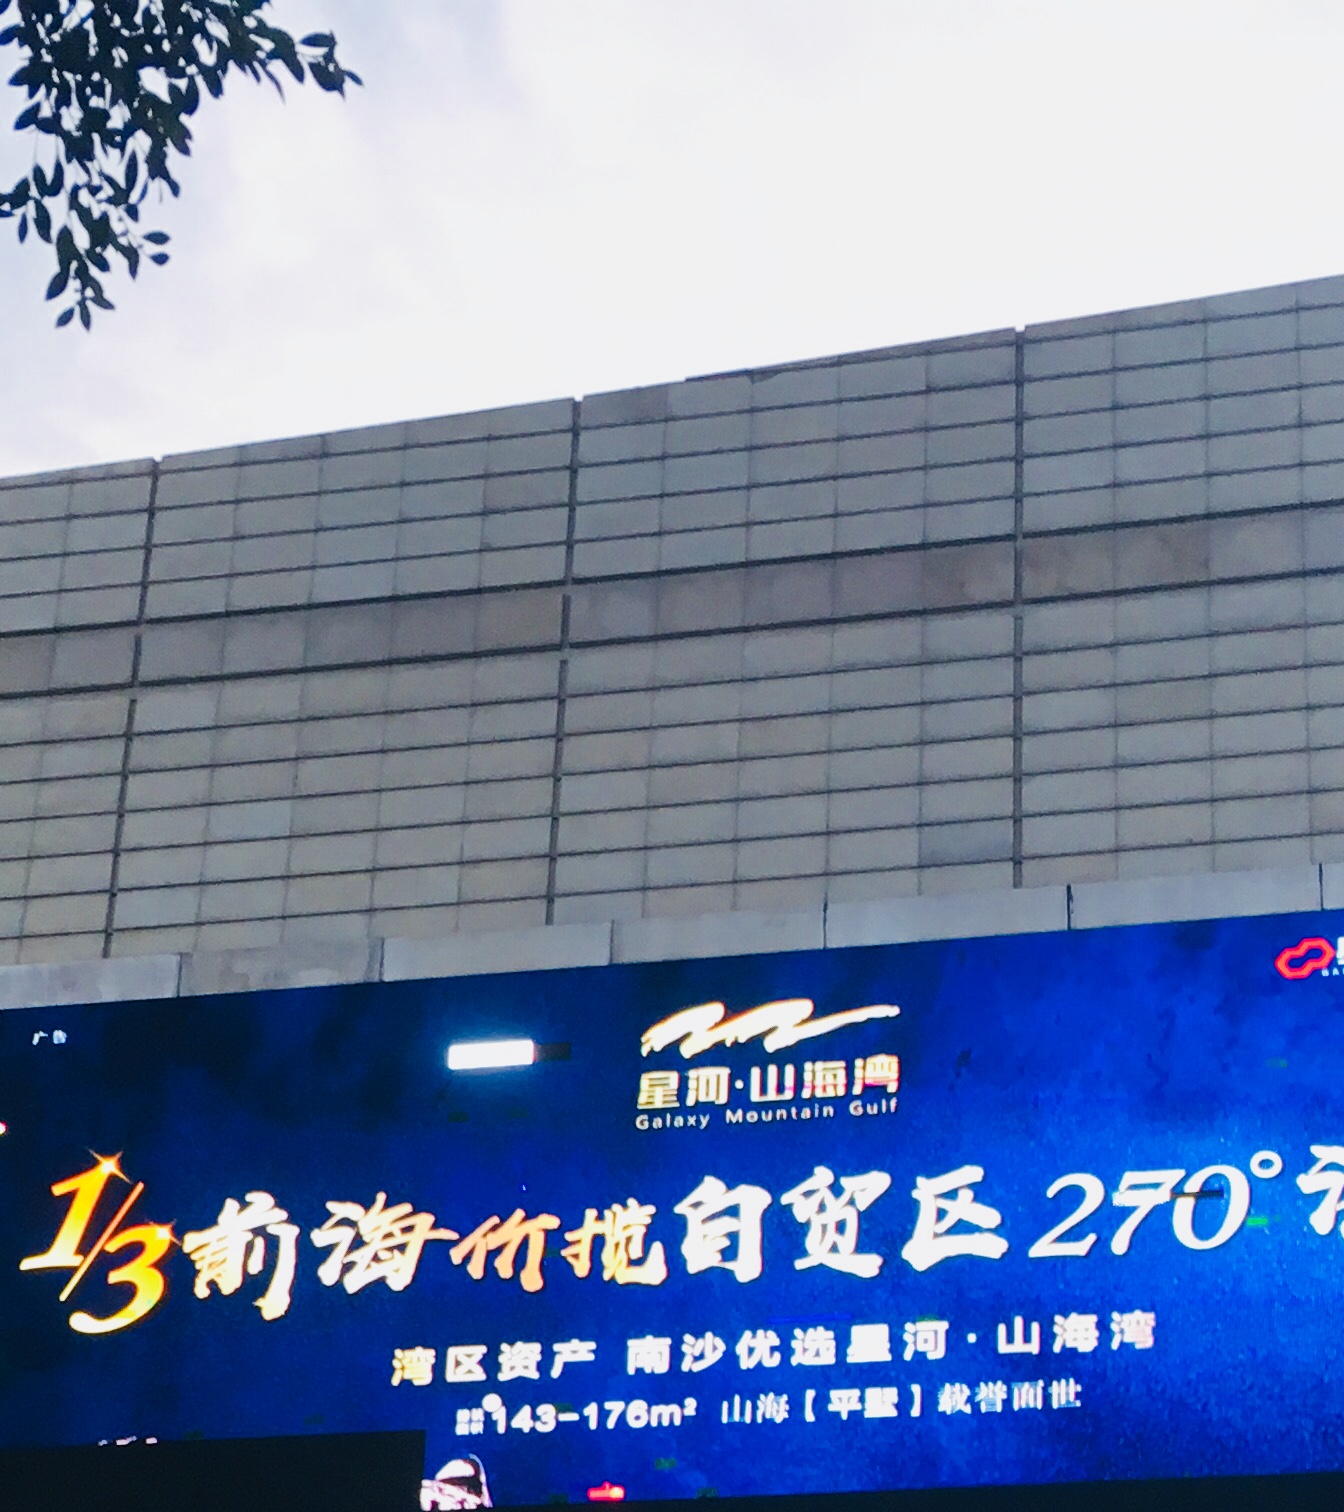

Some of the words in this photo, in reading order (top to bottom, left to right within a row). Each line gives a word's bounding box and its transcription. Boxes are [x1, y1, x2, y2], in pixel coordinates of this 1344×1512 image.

[635, 1112, 711, 1131] Galaxy
[725, 1103, 835, 1125] Mountain
[849, 1097, 898, 1117] Gulf
[390, 1339, 597, 1387] 湾区资产
